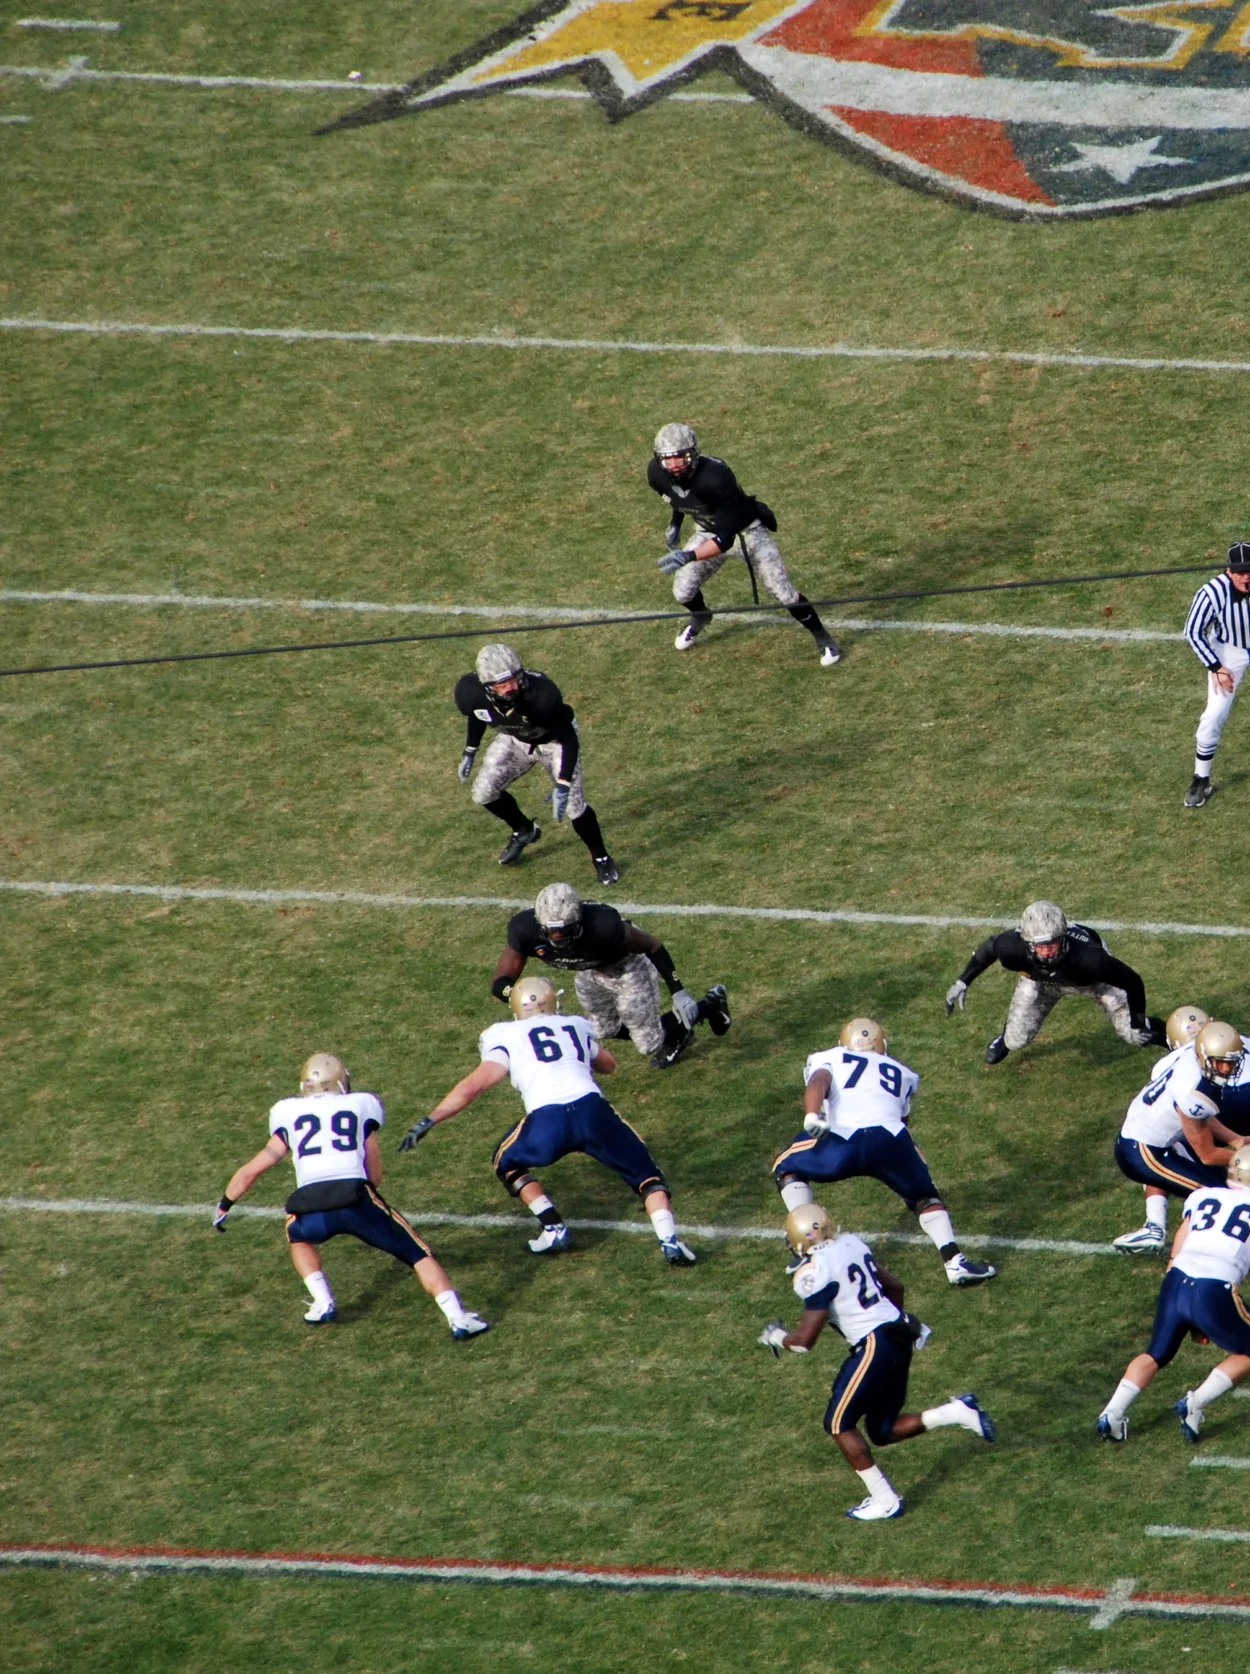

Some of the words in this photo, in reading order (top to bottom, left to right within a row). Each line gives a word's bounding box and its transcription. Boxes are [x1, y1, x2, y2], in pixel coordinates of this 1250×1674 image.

[528, 1025, 586, 1063] 61
[842, 1052, 902, 1098] 79
[294, 1110, 358, 1159] 29
